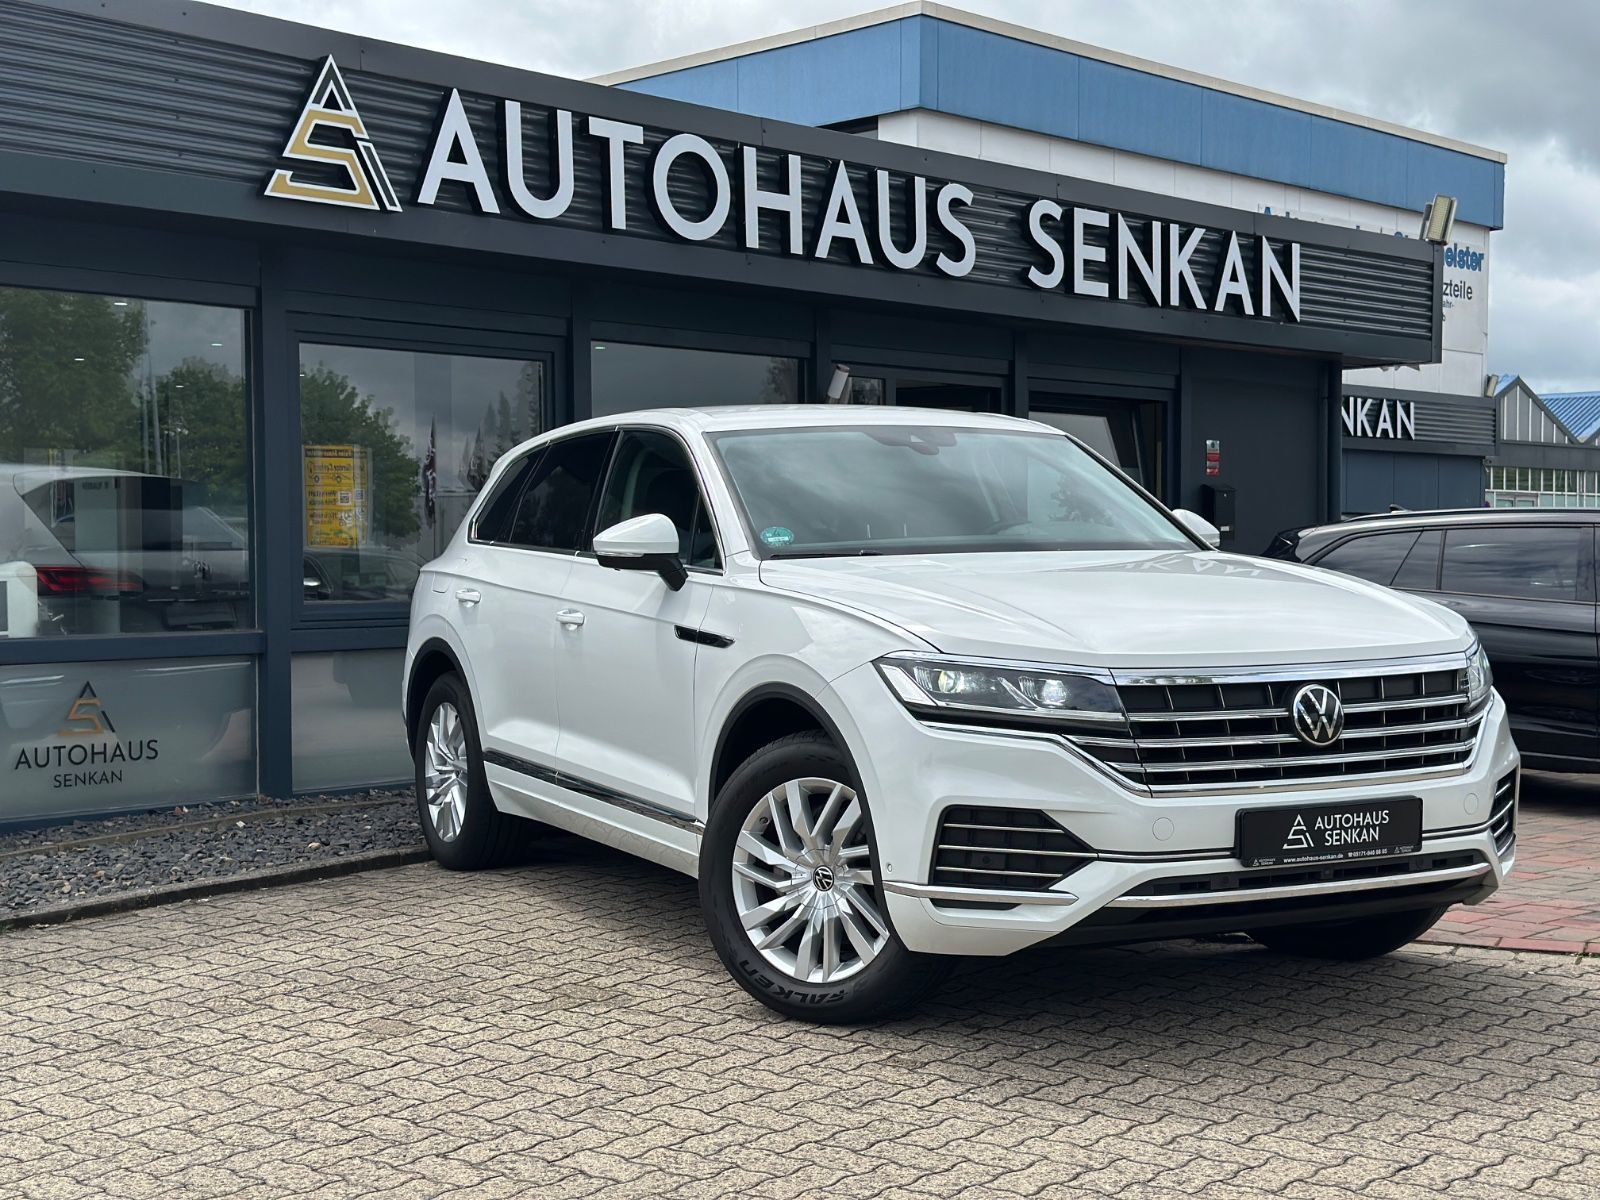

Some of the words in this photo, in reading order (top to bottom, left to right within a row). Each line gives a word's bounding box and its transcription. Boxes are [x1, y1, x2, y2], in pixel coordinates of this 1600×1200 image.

[417, 87, 976, 278] AUTOHAUS
[1028, 199, 1301, 323] SENKAN
[1443, 279, 1473, 301] zteile
[1341, 396, 1415, 441] NKAN
[14, 739, 159, 770] AUTOHAUS
[53, 769, 123, 789] SENKAN
[1314, 809, 1390, 831] AUTOHAUS
[1324, 826, 1379, 847] SENKAN
[738, 959, 850, 1005] FALKEN
